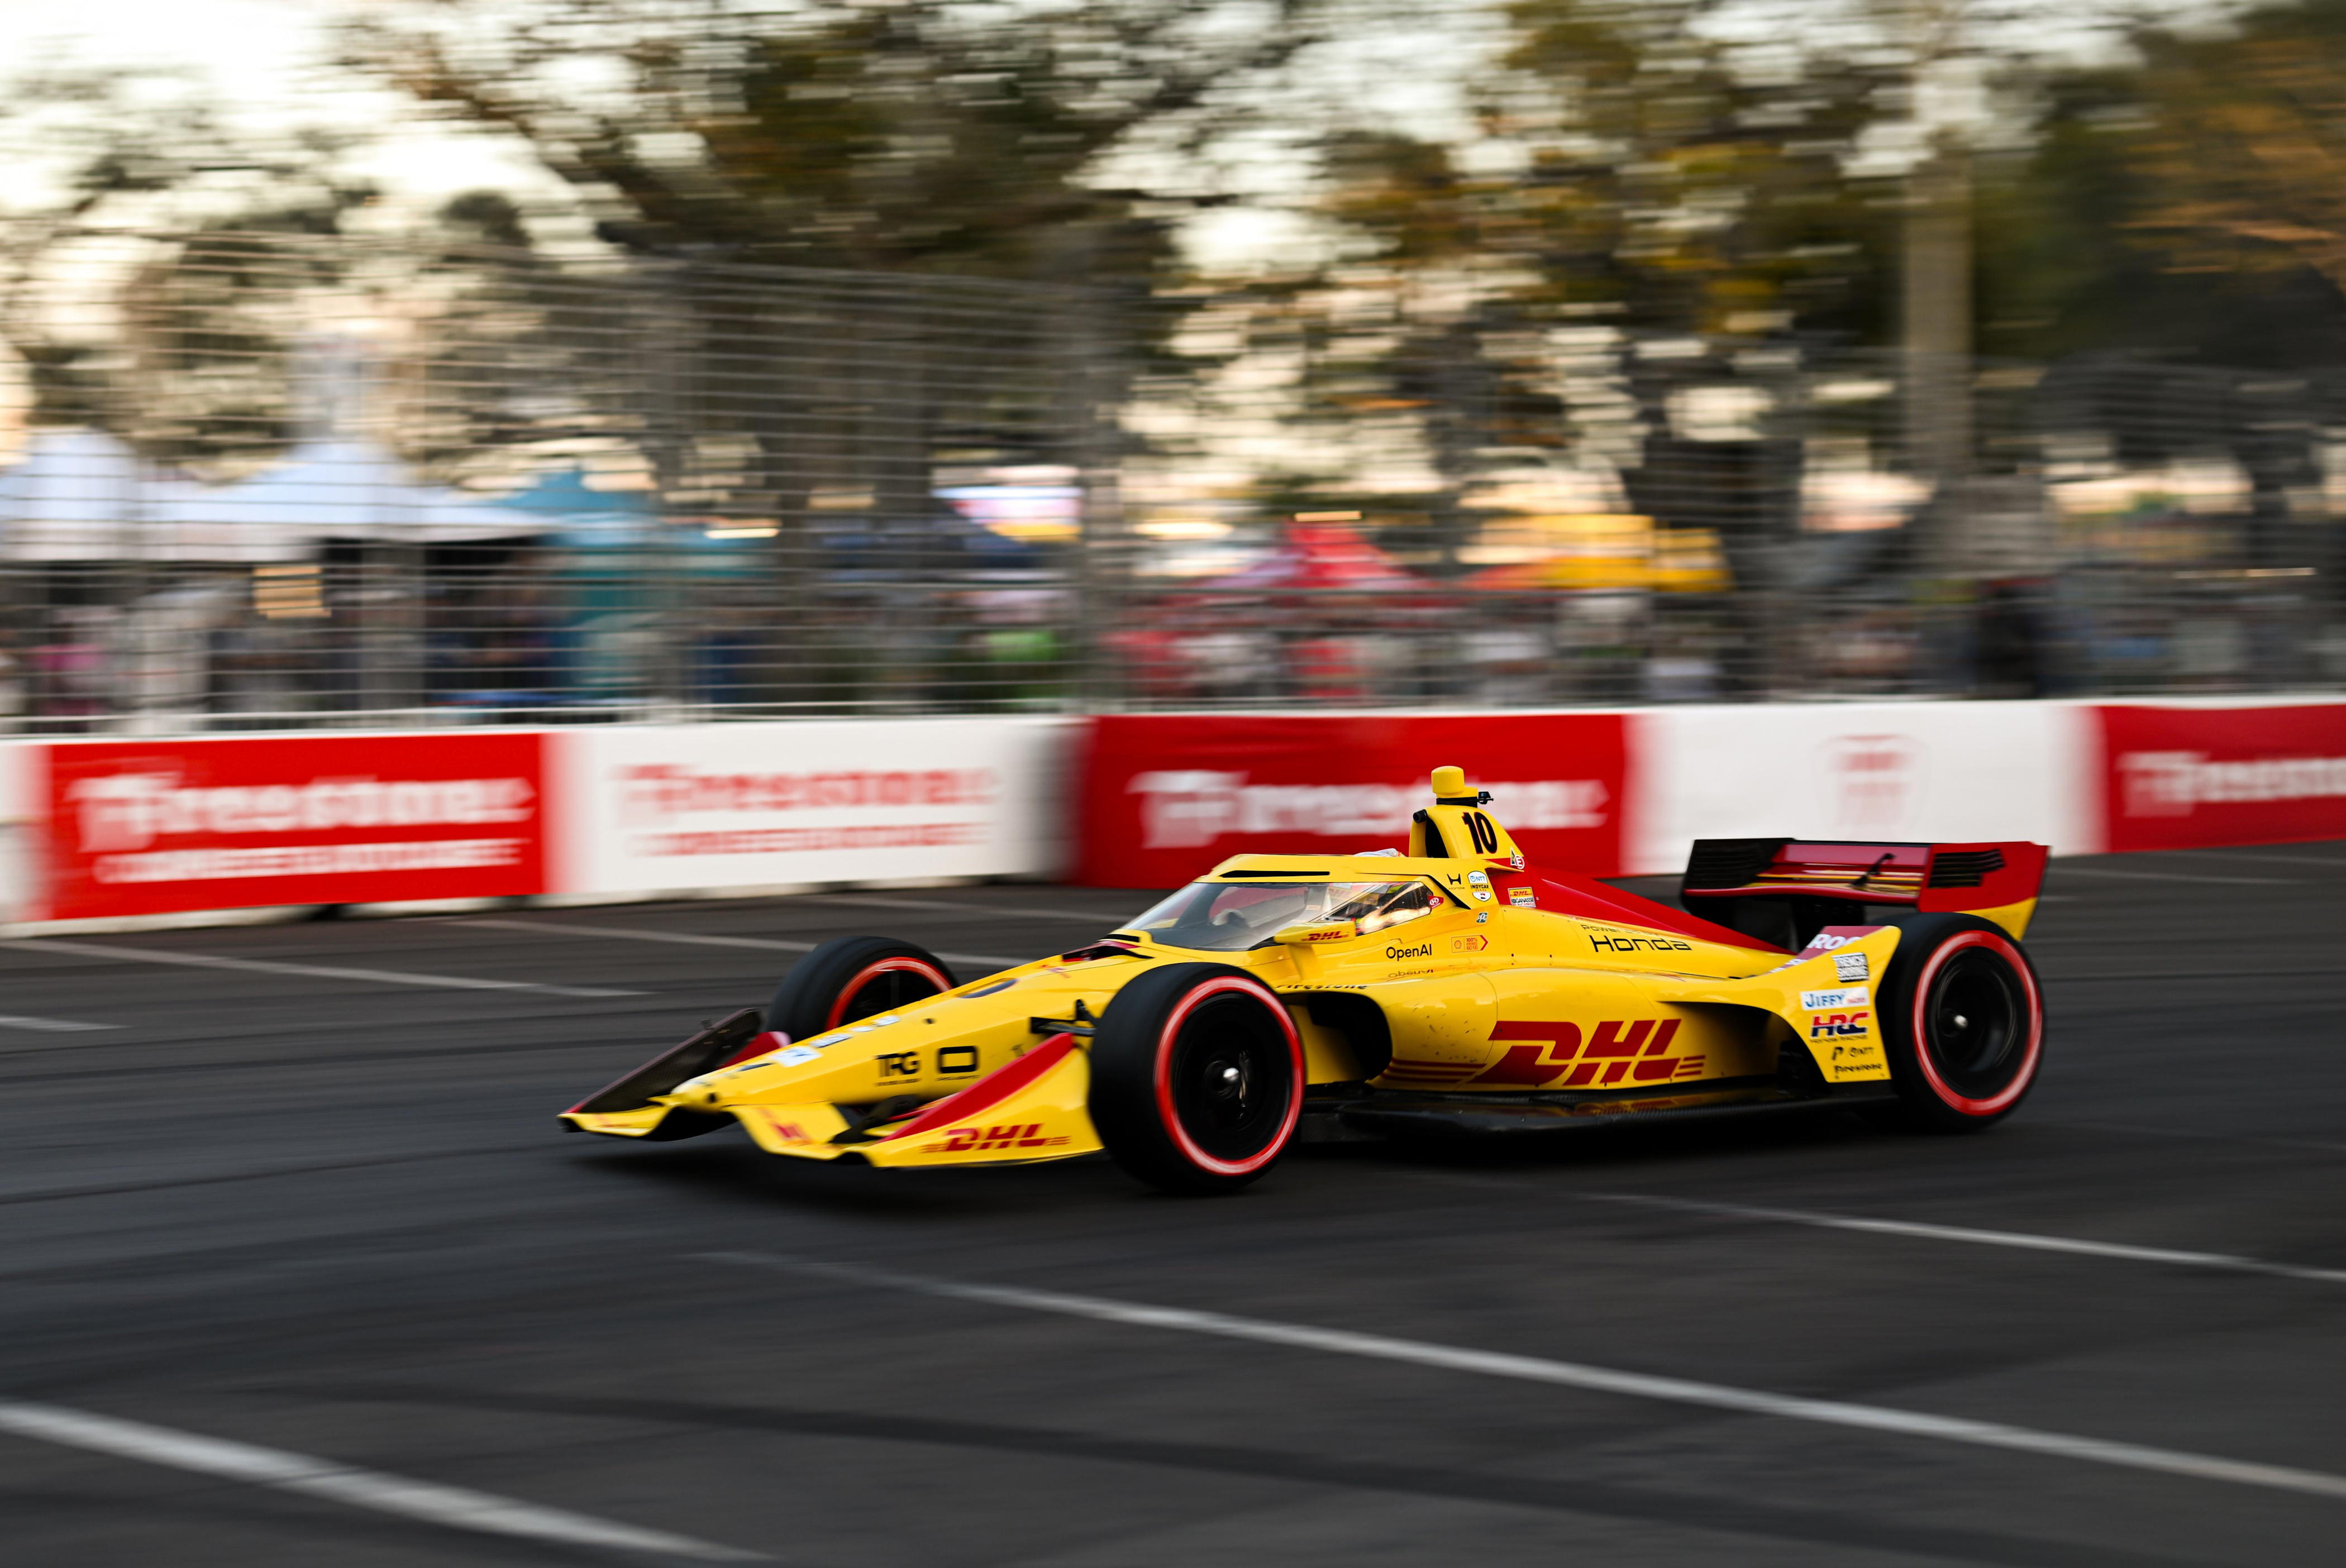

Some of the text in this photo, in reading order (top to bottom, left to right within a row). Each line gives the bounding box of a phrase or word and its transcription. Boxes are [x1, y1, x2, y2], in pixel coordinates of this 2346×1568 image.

[1461, 812, 1498, 854] 10
[1307, 931, 1342, 941] DHL
[1589, 935, 1692, 953] Honda
[1386, 943, 1432, 962] OpenAI
[1805, 993, 1846, 1007] JIFFY
[1810, 1012, 1869, 1038] HRC
[1465, 1019, 1681, 1086] DHL
[944, 1123, 1045, 1151] DHL
